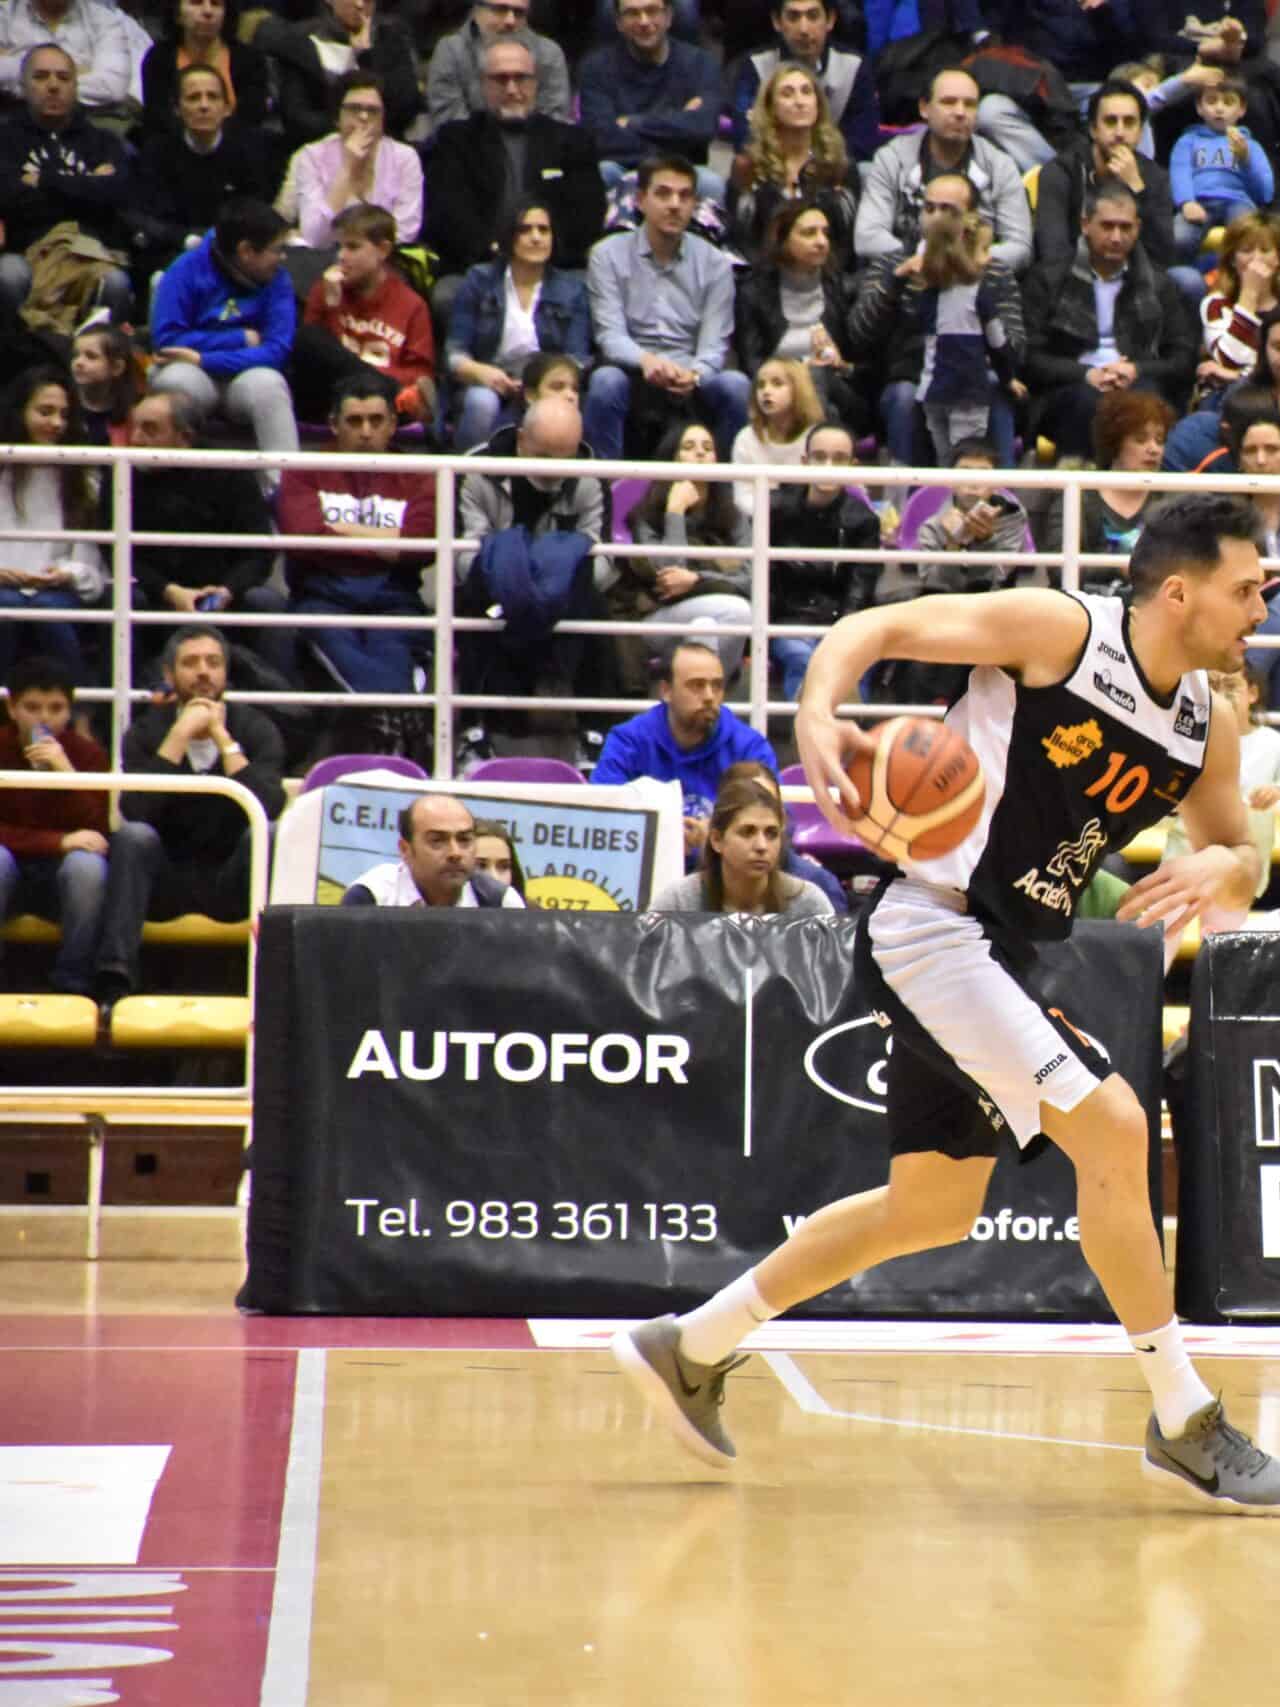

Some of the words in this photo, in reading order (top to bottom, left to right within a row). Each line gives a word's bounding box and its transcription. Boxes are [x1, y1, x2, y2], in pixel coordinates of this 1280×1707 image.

[1083, 751, 1149, 813] 10
[330, 803, 402, 834] C.E.I.
[532, 822, 640, 854] DELIBES
[346, 1029, 691, 1084] AUTOFOR
[345, 1198, 432, 1237] Tel.
[445, 1200, 540, 1241] 983
[551, 1202, 628, 1241] 361
[643, 1203, 719, 1242] 133
